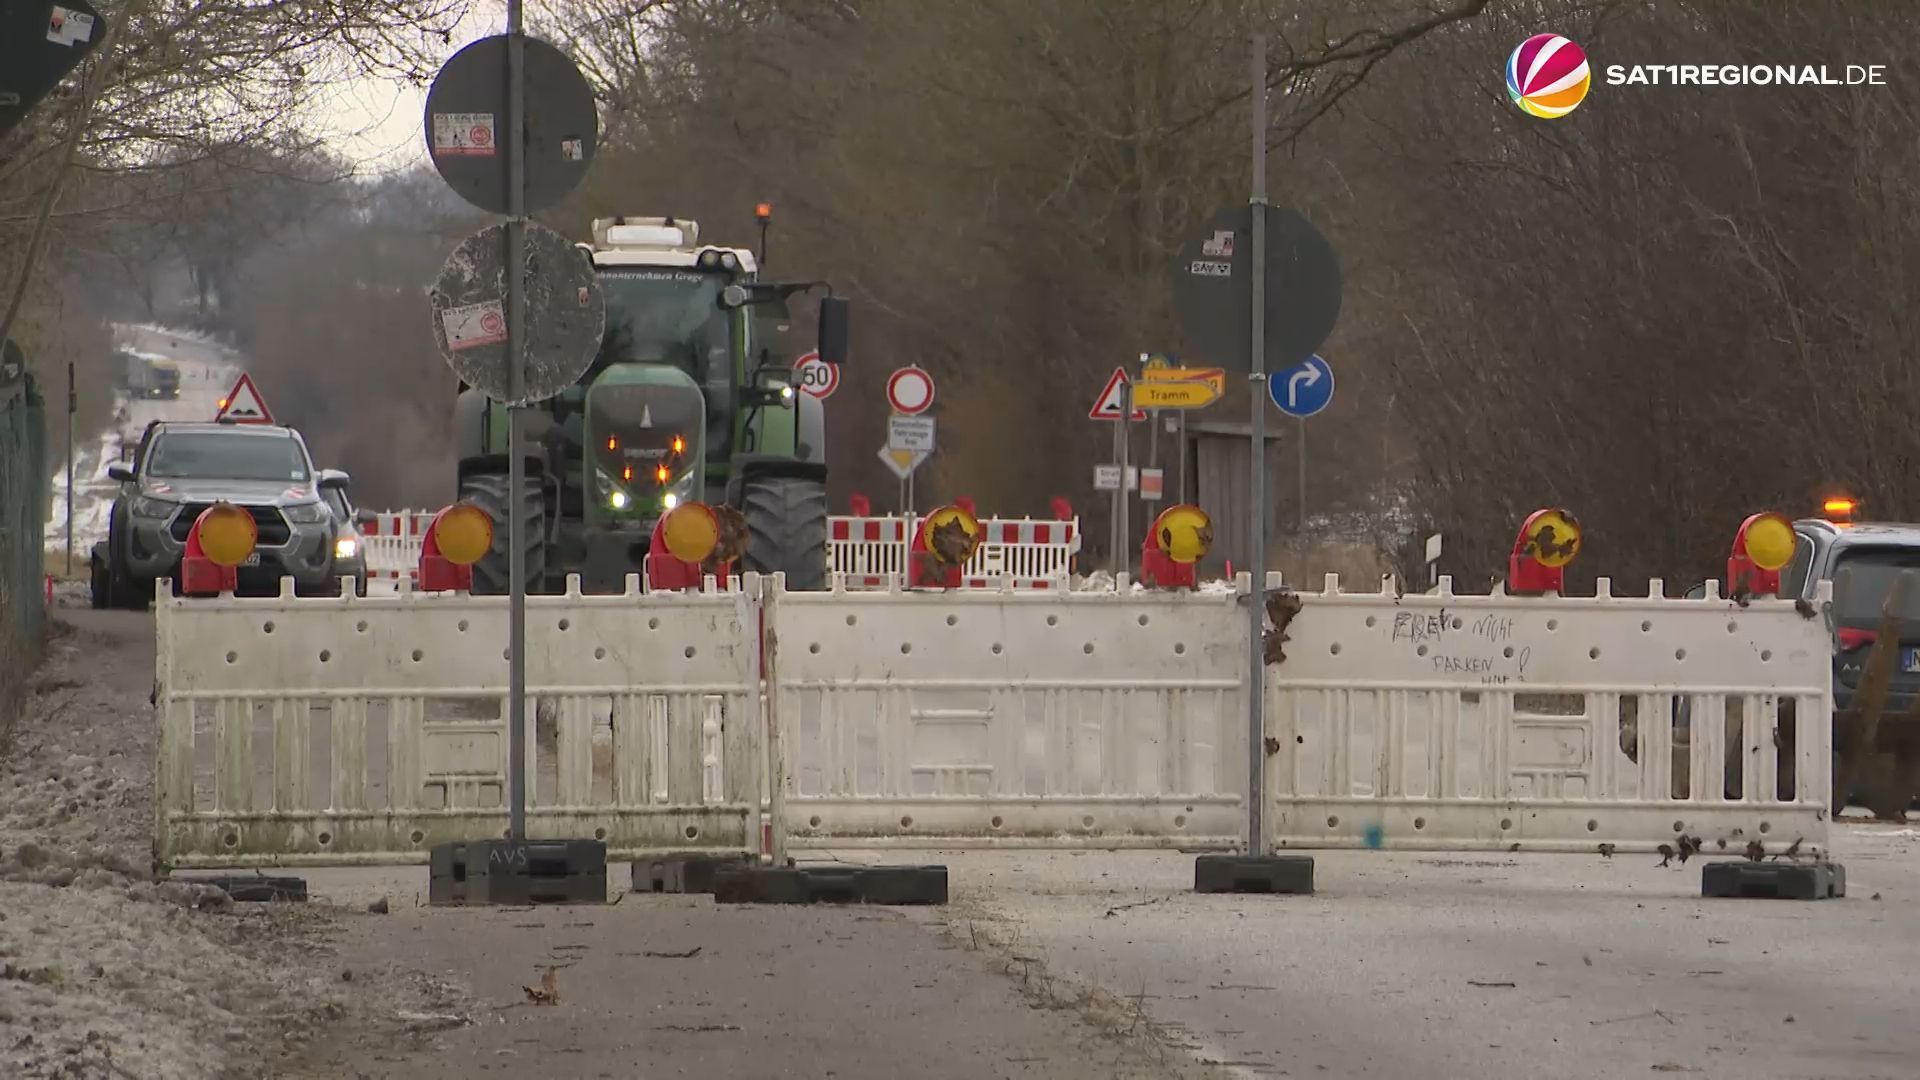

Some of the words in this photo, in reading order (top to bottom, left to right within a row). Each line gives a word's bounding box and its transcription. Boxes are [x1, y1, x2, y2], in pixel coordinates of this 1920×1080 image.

[803, 365, 829, 387] 50
[1149, 389, 1190, 400] Tramm
[1432, 655, 1494, 673] PARKEN
[489, 847, 527, 865] AVS
